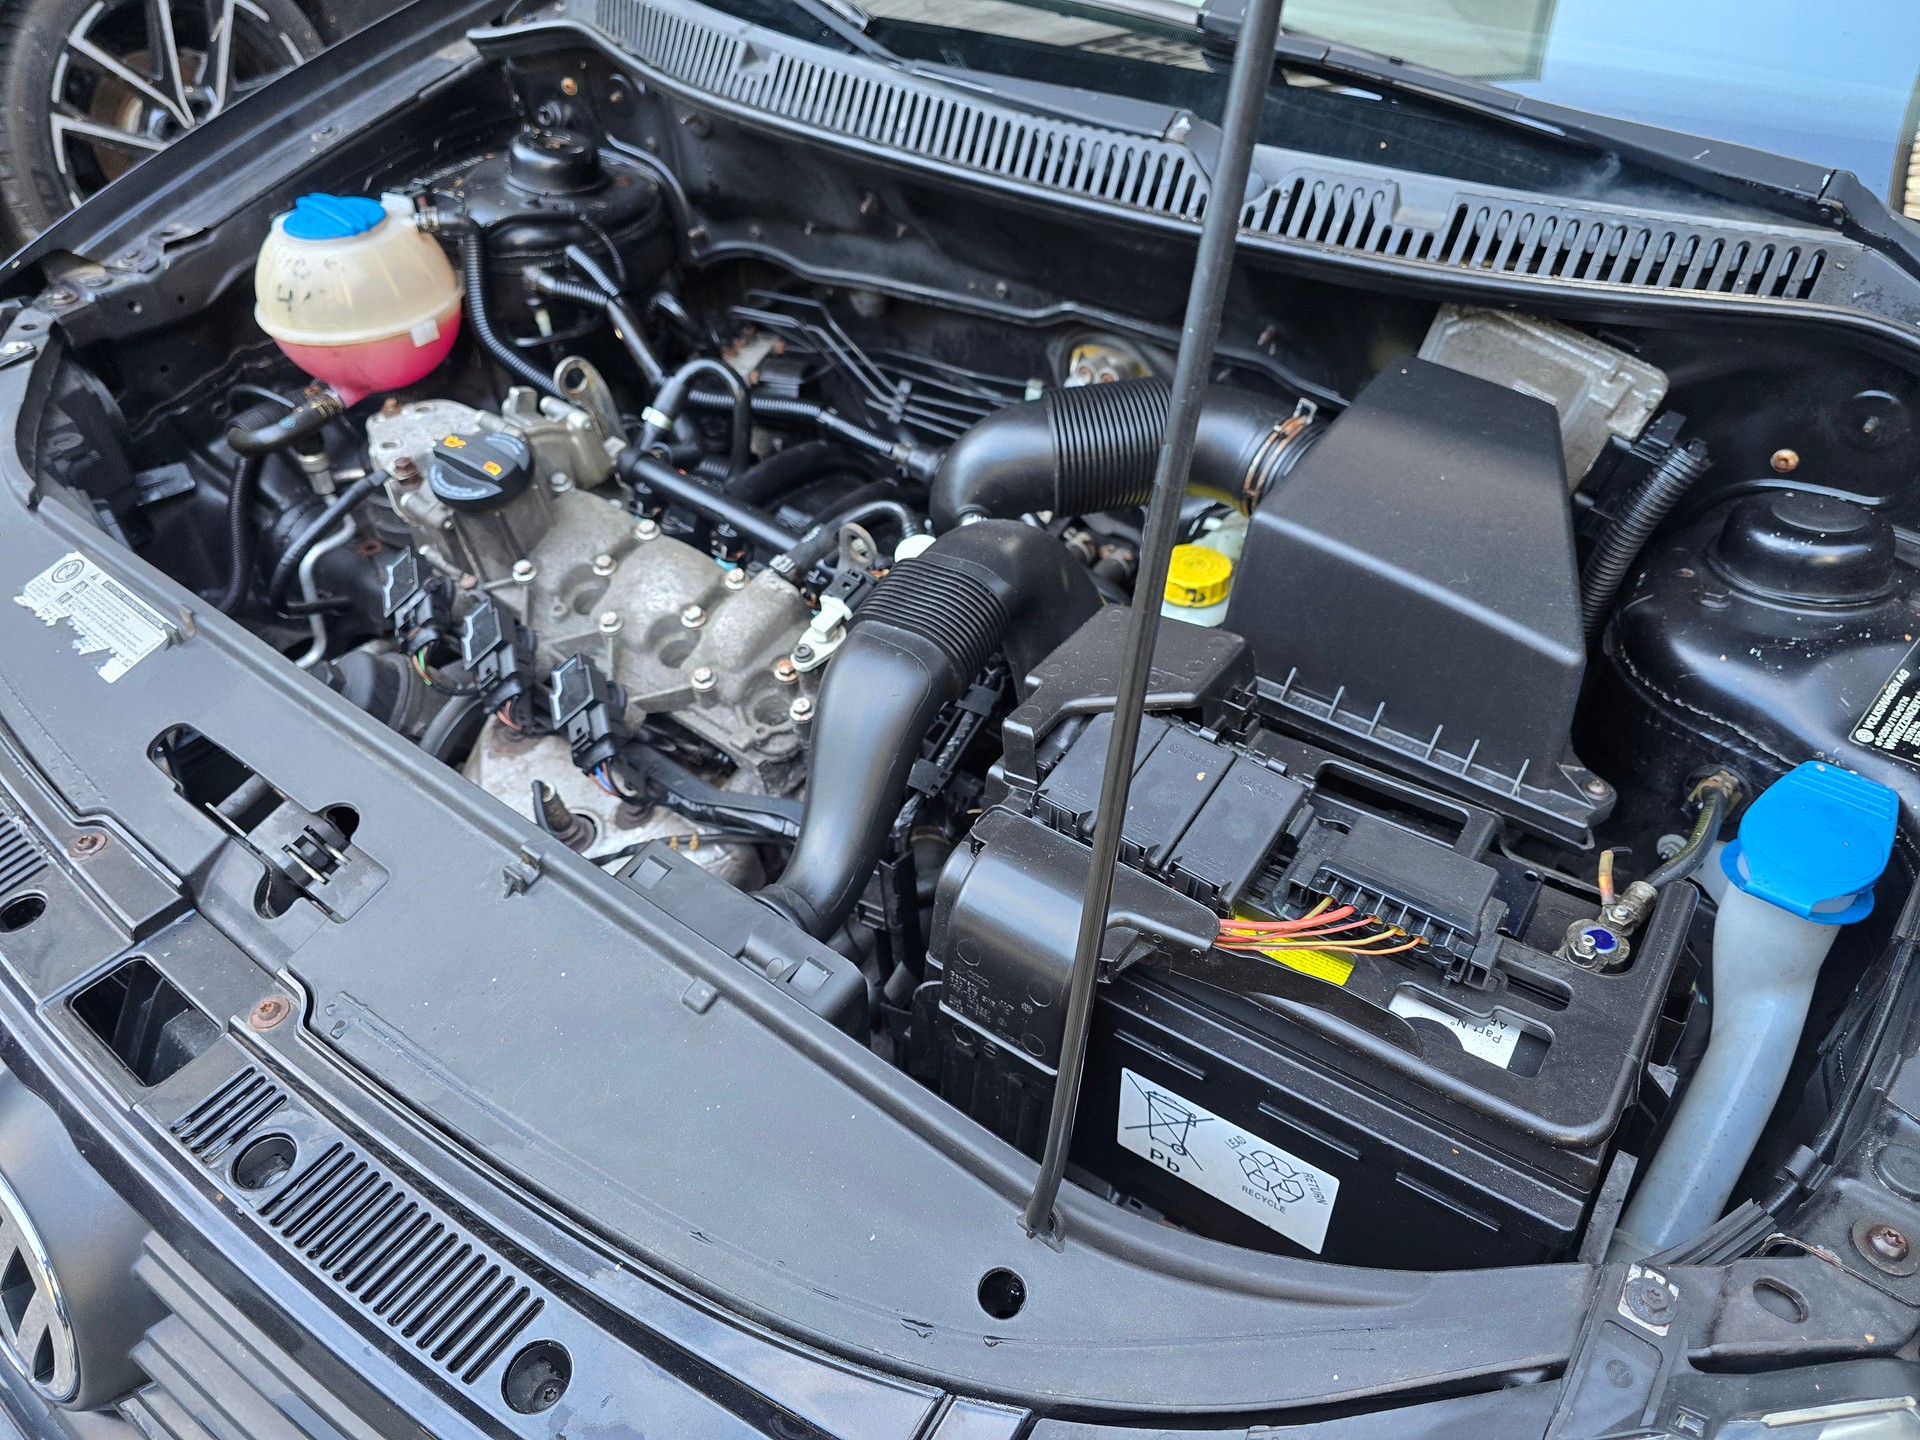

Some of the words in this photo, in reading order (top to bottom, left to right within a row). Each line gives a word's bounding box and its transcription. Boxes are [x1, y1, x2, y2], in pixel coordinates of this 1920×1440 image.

[1862, 679, 1903, 730] VOLKSWAGEN
[1896, 668, 1911, 684] AG
[1472, 1026, 1503, 1044] Part
[1223, 1135, 1247, 1150] LEAD
[1149, 1147, 1181, 1173] Pb
[1241, 1185, 1287, 1215] RECYCLE
[1302, 1171, 1329, 1206] RETURN
